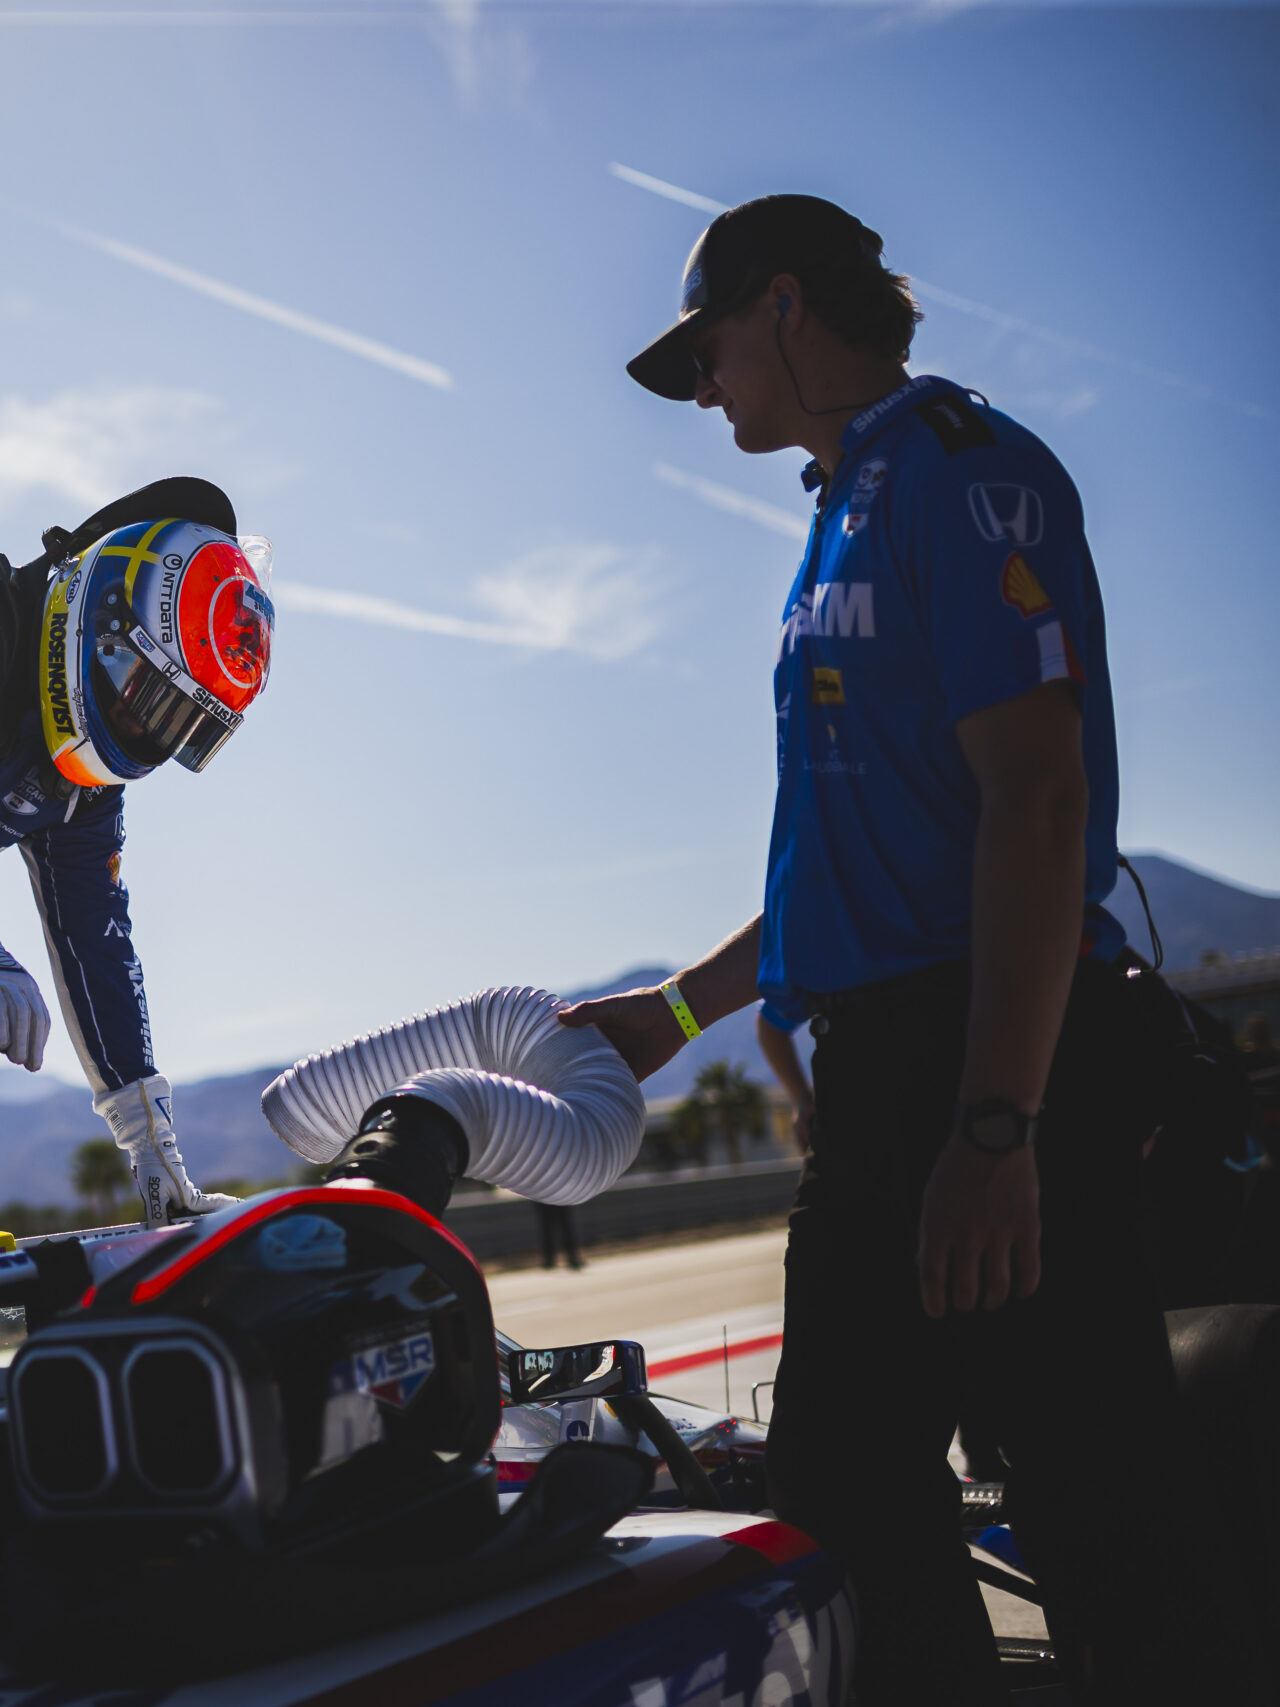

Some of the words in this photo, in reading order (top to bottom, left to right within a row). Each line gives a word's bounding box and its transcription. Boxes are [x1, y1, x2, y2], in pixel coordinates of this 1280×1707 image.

[161, 572, 175, 599] NTT
[48, 612, 78, 738] ROSENQVIST
[150, 1176, 163, 1220] sparco
[356, 1336, 433, 1388] MSR
